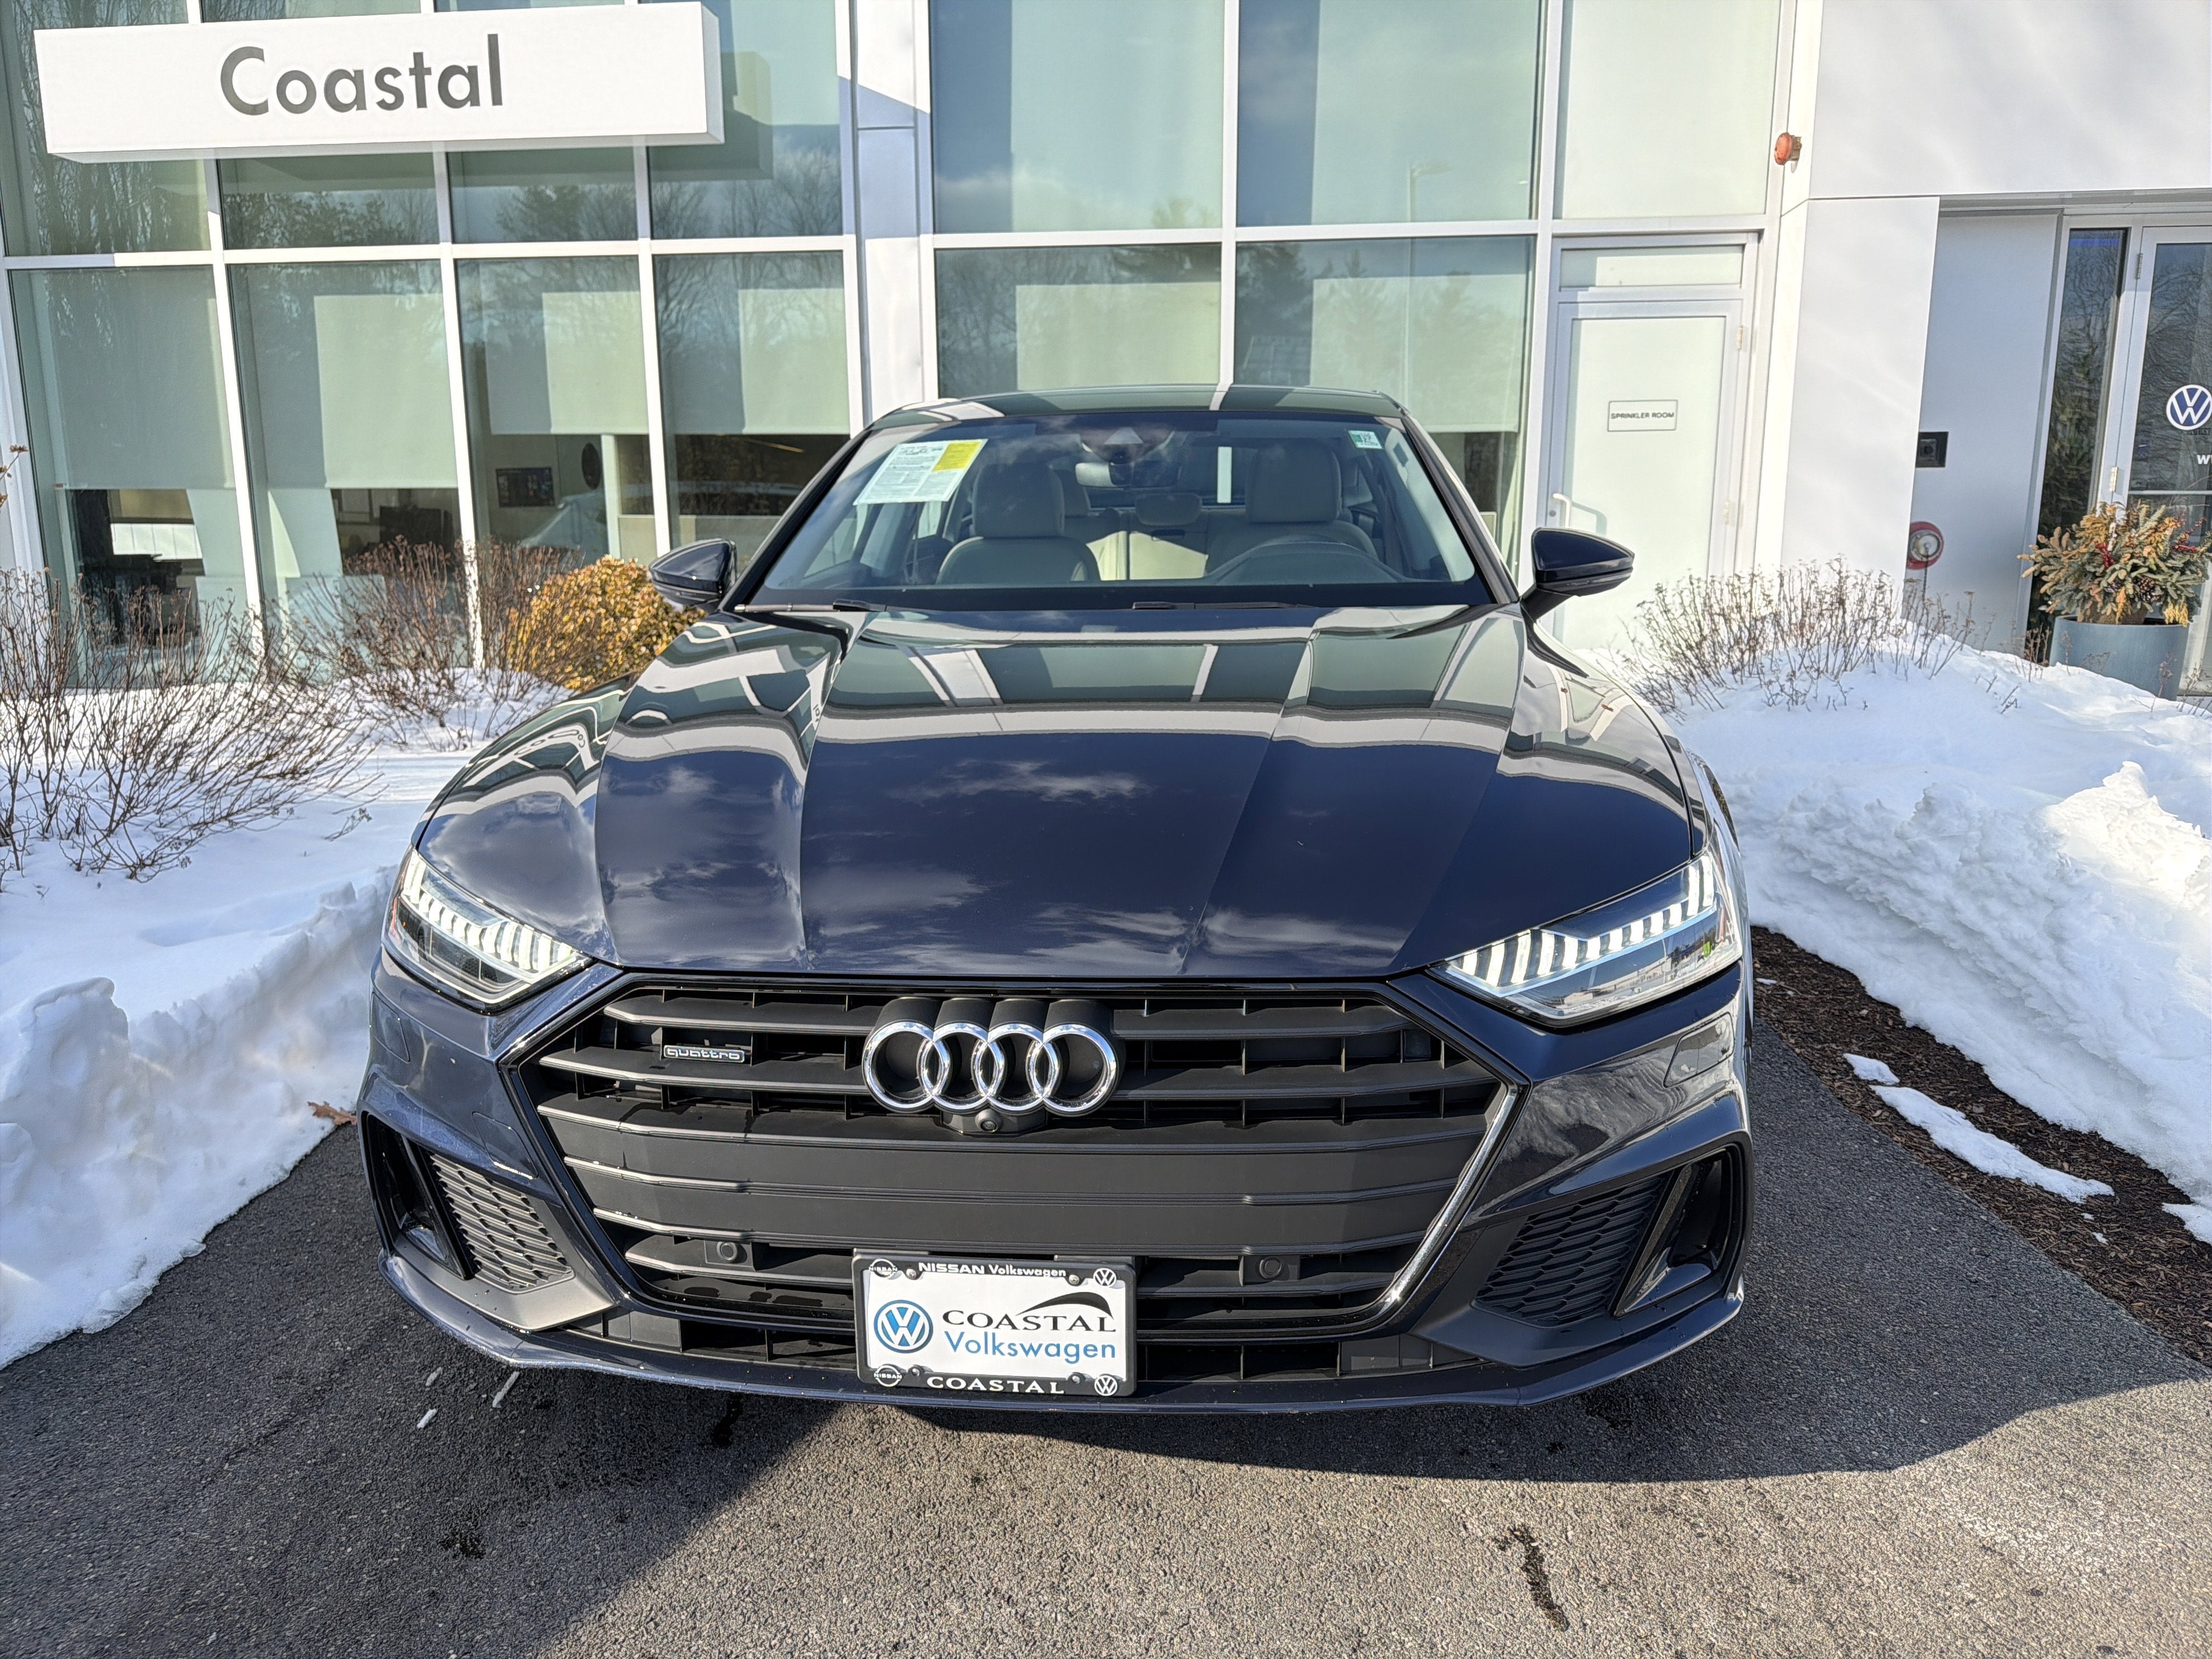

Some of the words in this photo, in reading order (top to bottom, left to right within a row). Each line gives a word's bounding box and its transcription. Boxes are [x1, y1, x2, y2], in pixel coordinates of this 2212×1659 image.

[221, 33, 503, 116] Coastal
[667, 1048, 740, 1059] quattro
[918, 1262, 985, 1274] NISSAN
[988, 1264, 1066, 1277] Volkswagen
[942, 1310, 1116, 1333] COASTAL
[944, 1330, 1116, 1364] Volkswagen
[927, 1376, 1066, 1395] COASTAL
